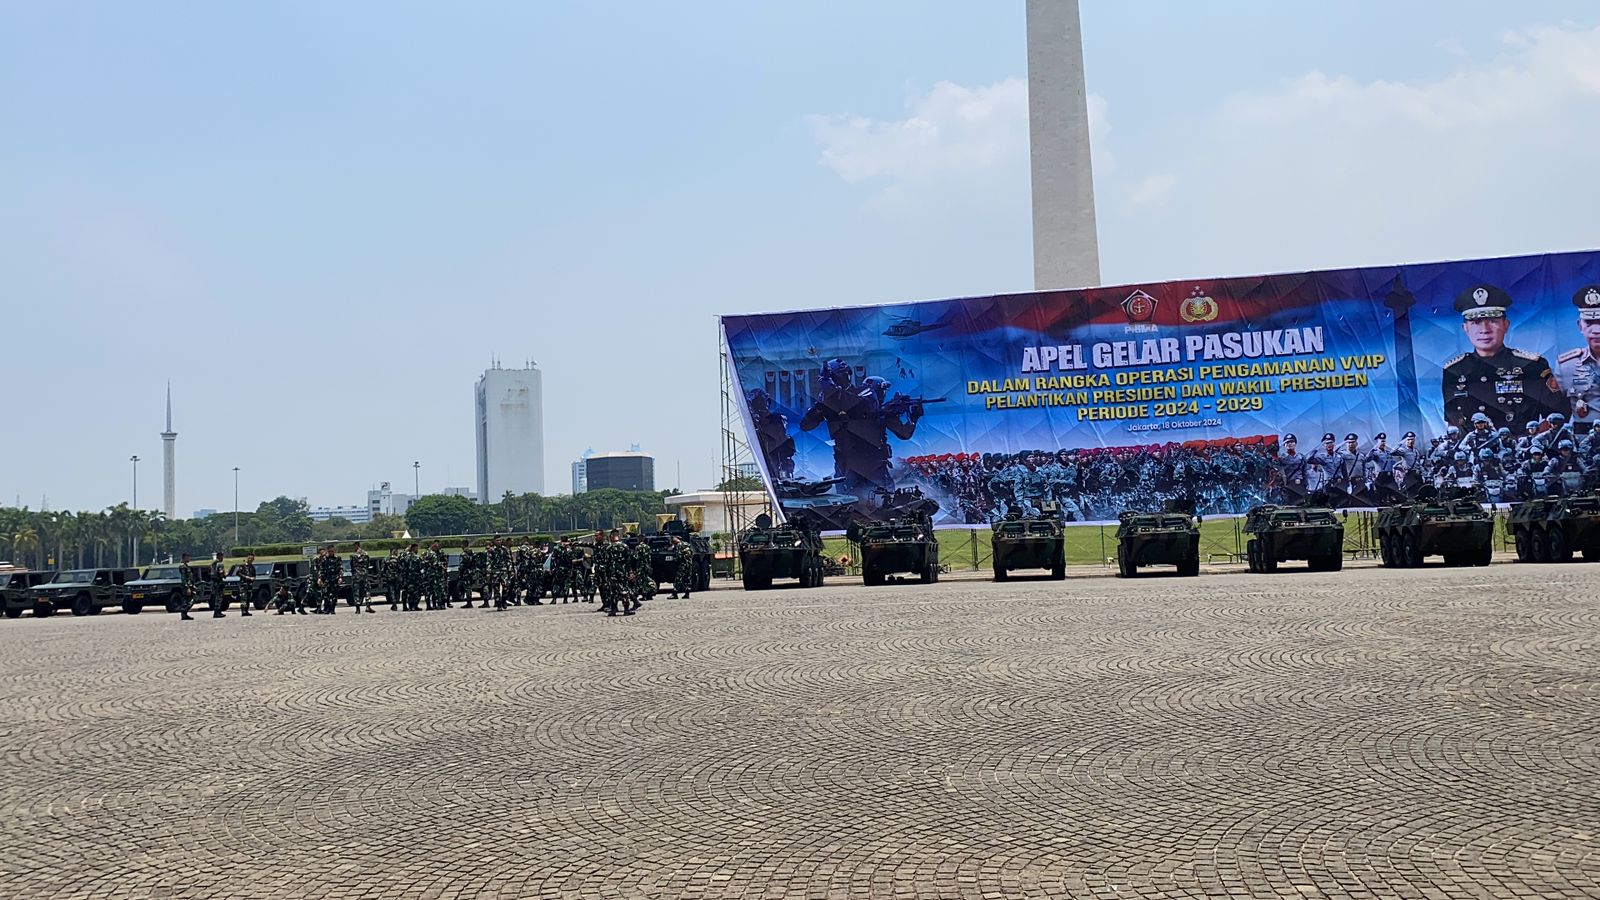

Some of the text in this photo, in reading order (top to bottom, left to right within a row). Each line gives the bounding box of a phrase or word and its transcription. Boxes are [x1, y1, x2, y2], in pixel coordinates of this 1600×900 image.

[1021, 326, 1324, 372] APEL GELAR PASUKAN
[967, 354, 1385, 394] DALAM RANGKA OPERASI PENGAMANAN VVIP
[986, 373, 1369, 409] PELANTIKAN PRESIDEN DAN WAKIL PRESIDEN
[1077, 405, 1149, 421] PERIODE
[1153, 400, 1199, 417] 2024
[1216, 396, 1263, 412] 2029
[1127, 418, 1222, 432] Jakarta, 18 Oktober 2024
